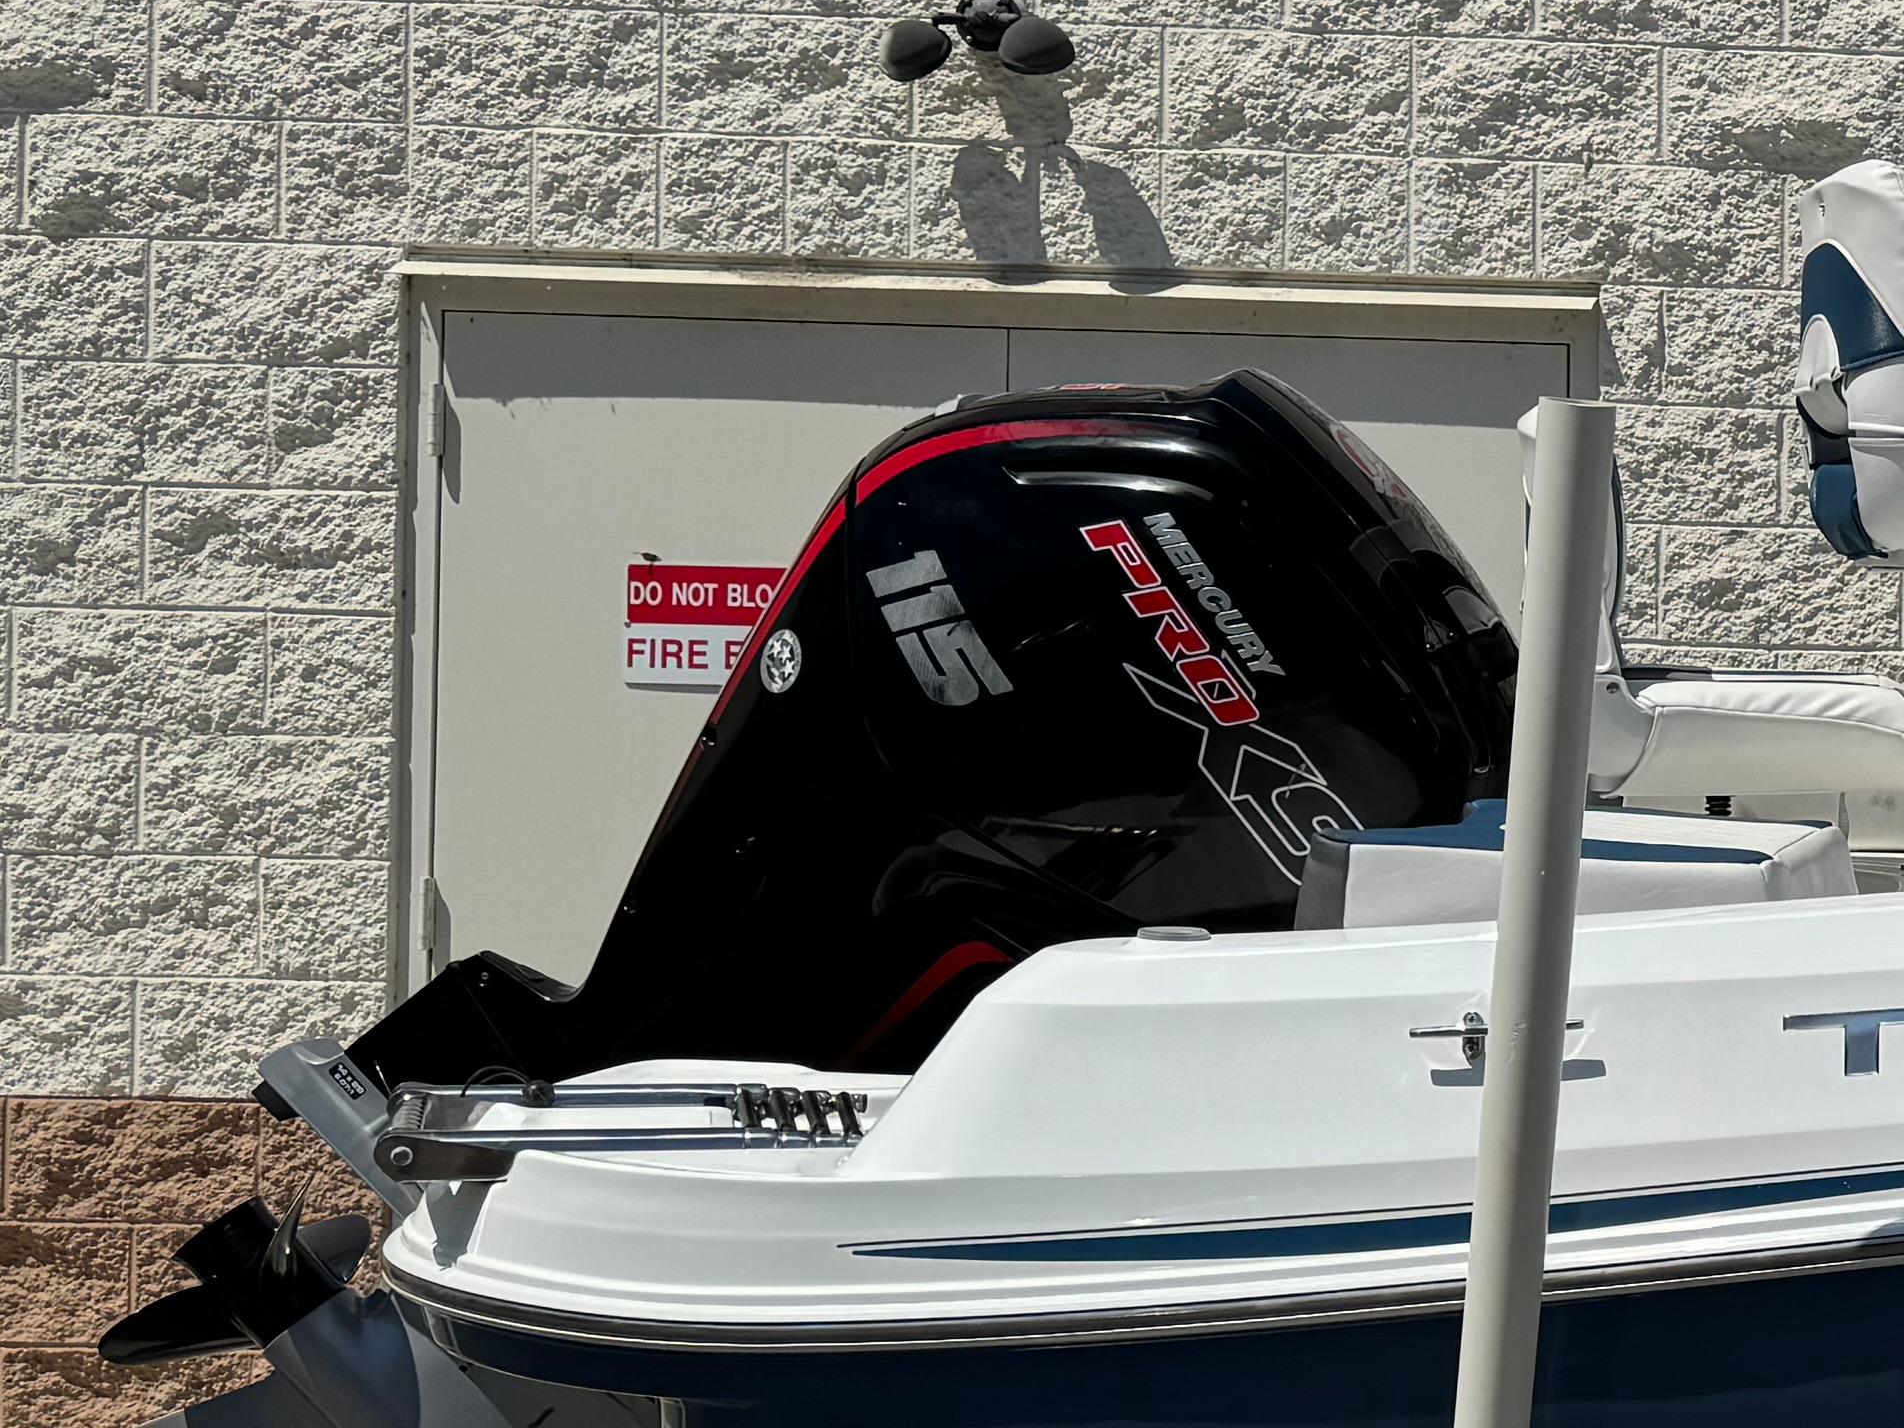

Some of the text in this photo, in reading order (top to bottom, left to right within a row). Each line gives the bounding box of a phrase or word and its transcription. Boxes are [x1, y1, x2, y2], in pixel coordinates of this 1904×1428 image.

[626, 638, 709, 670] FIRE
[629, 580, 663, 606] DO
[671, 582, 719, 608] NOT
[866, 549, 1014, 707] 115
[1078, 518, 1261, 727] PRO
[1142, 511, 1287, 676] MERCURY
